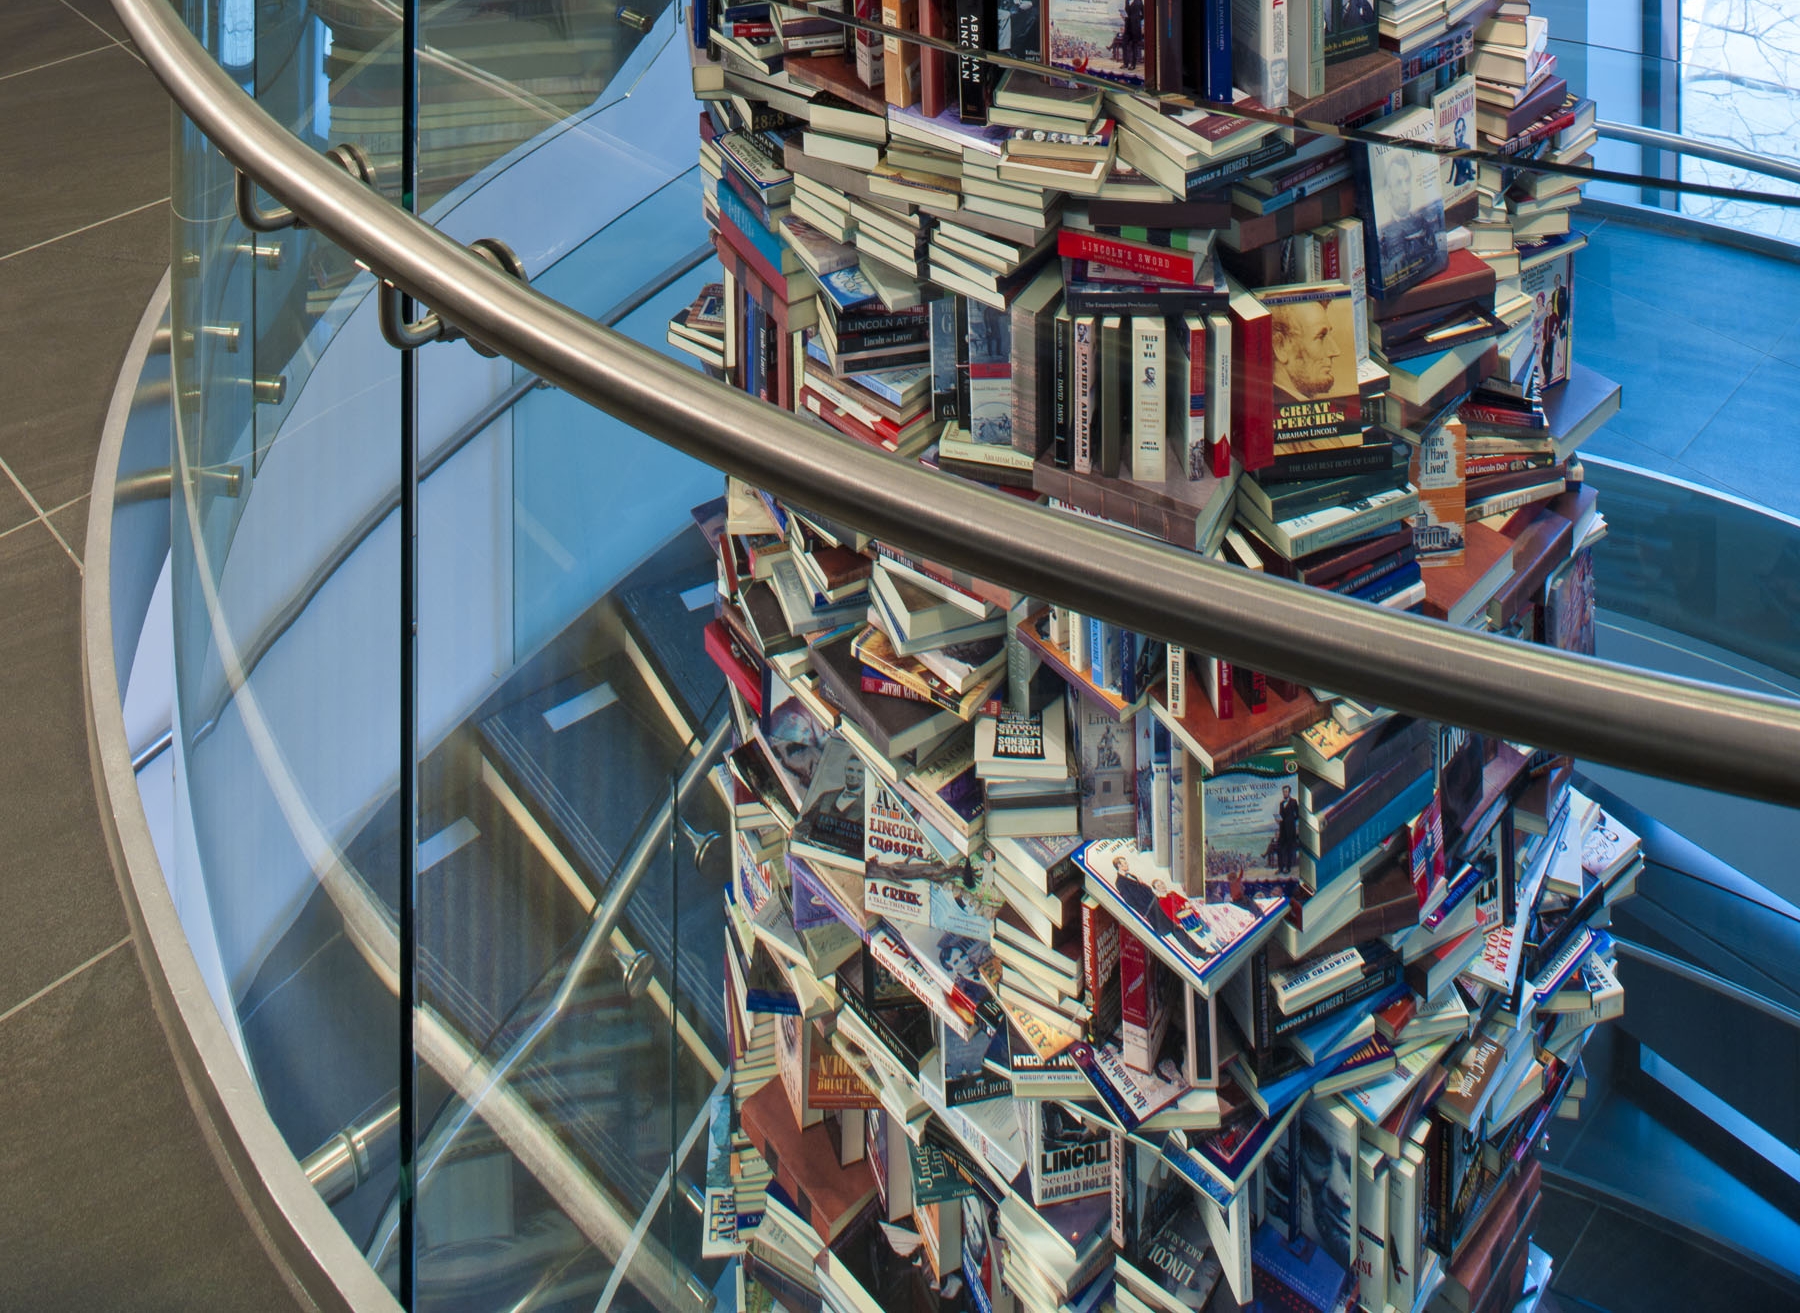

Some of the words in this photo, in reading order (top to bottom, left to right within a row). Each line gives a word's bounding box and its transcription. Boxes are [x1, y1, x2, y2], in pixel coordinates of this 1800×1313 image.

[1439, 100, 1458, 128] ABRAHAM
[1458, 93, 1474, 119] LINCOLN
[1505, 141, 1518, 155] FIERY
[1518, 135, 1532, 149] TRIAL
[1186, 168, 1222, 189] LINCOLN'S
[1222, 156, 1249, 176] AVENGERS
[1082, 240, 1132, 261] LINCOLN'S
[1138, 252, 1170, 269] SWORD
[848, 318, 893, 332] LINCOLN
[896, 316, 908, 327] AT
[1140, 334, 1158, 343] TRIED
[1143, 351, 1156, 359] WAR
[1279, 402, 1331, 418] GREAT
[1473, 409, 1498, 422] WAY
[1273, 412, 1345, 430] SPEECHES
[1276, 430, 1309, 441] ABRAHAM
[1310, 426, 1338, 436] LINCOLN
[1476, 464, 1496, 473] Lincoln
[1496, 462, 1508, 472] Do?
[1483, 504, 1499, 516] Our
[1500, 494, 1532, 510] Lincoln
[876, 540, 894, 560] FIERY
[896, 550, 914, 570] TRIAL
[998, 736, 1042, 746] LEGENDS
[998, 744, 1042, 755] LINCOLN
[1205, 786, 1224, 796] JUST
[1225, 785, 1230, 794] A
[1232, 784, 1248, 792] FEW
[1249, 782, 1277, 791] WORDS,
[1218, 795, 1230, 803] MR.
[1232, 792, 1267, 802] LINCOLN
[869, 818, 924, 845] LINCOLN
[868, 834, 924, 858] CROSSES
[869, 882, 879, 896] A
[882, 885, 924, 907] CREEK
[874, 946, 908, 982] LINCOLN'S
[908, 980, 934, 1010] WRATH
[1280, 972, 1311, 991] BRUCE
[1312, 951, 1356, 976] CHADWICK
[1276, 1008, 1314, 1034] LINCOLN'S
[1314, 992, 1344, 1017] AVENGERS
[1482, 1042, 1499, 1063] Wayne
[1461, 1068, 1483, 1098] Temple
[954, 1088, 978, 1103] GABOR
[1042, 1182, 1080, 1200] HAROLD
[1082, 1174, 1111, 1191] HOLZE
